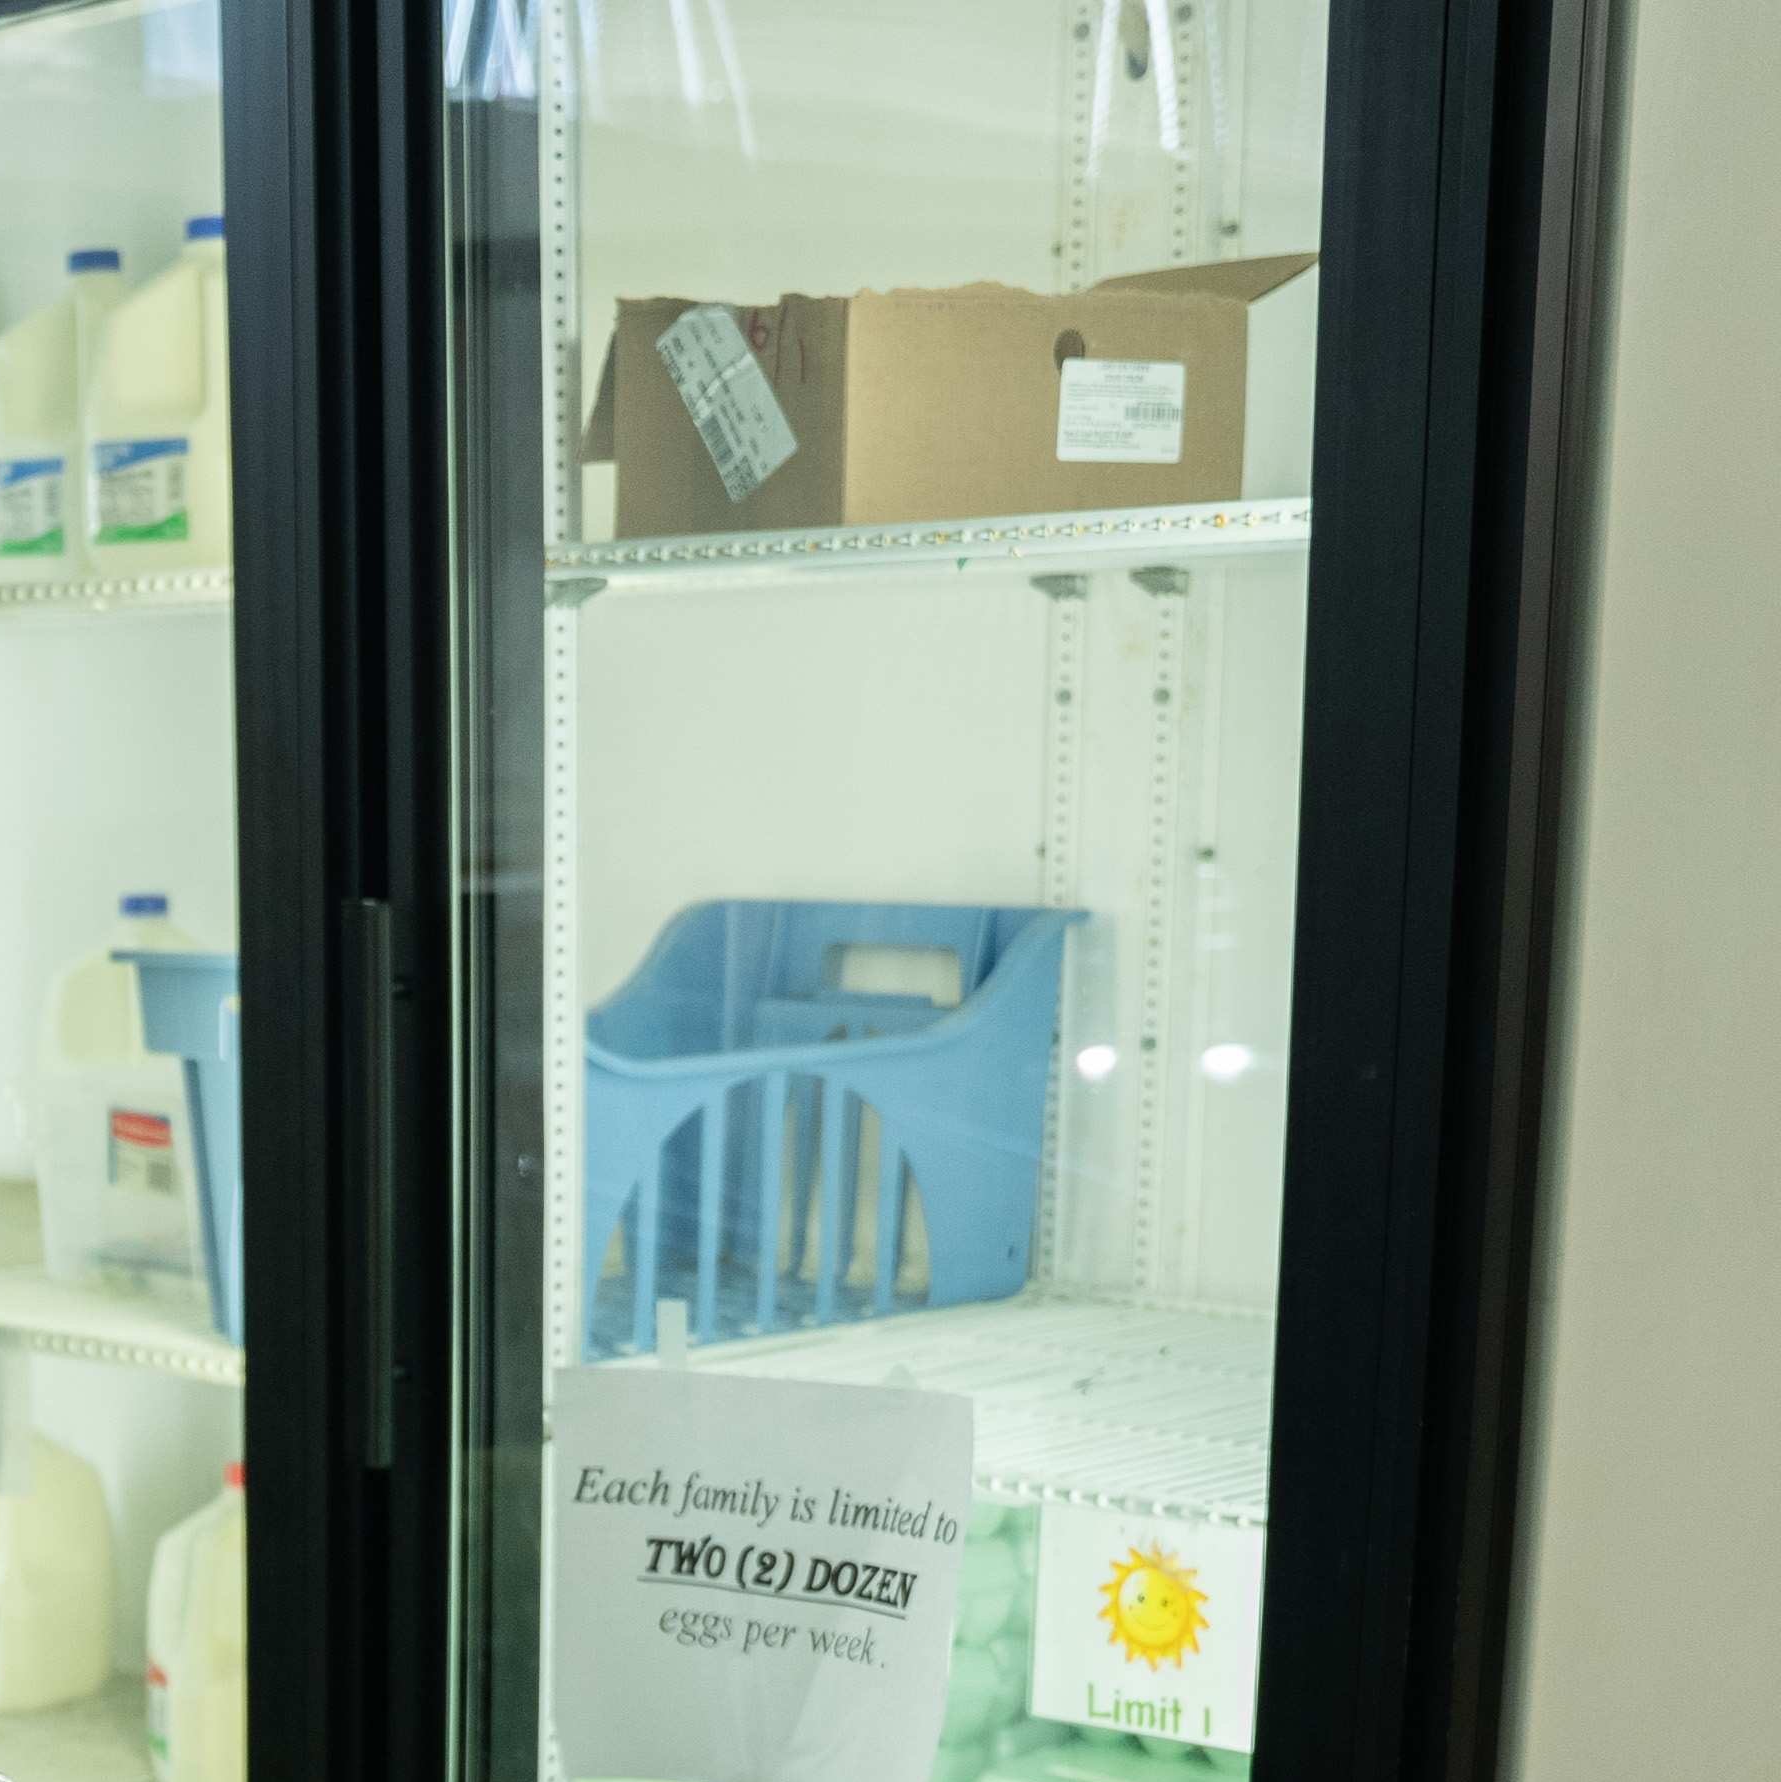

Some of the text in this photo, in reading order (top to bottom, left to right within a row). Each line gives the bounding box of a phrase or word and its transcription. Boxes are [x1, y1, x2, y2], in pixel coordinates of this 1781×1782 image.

[573, 1466, 959, 1545] Each family is limited to
[645, 1535, 918, 1610] TWO (2) DOZEN
[659, 1606, 733, 1646] eggs
[743, 1619, 797, 1655] per
[1087, 1681, 1212, 1737] Limit 1
